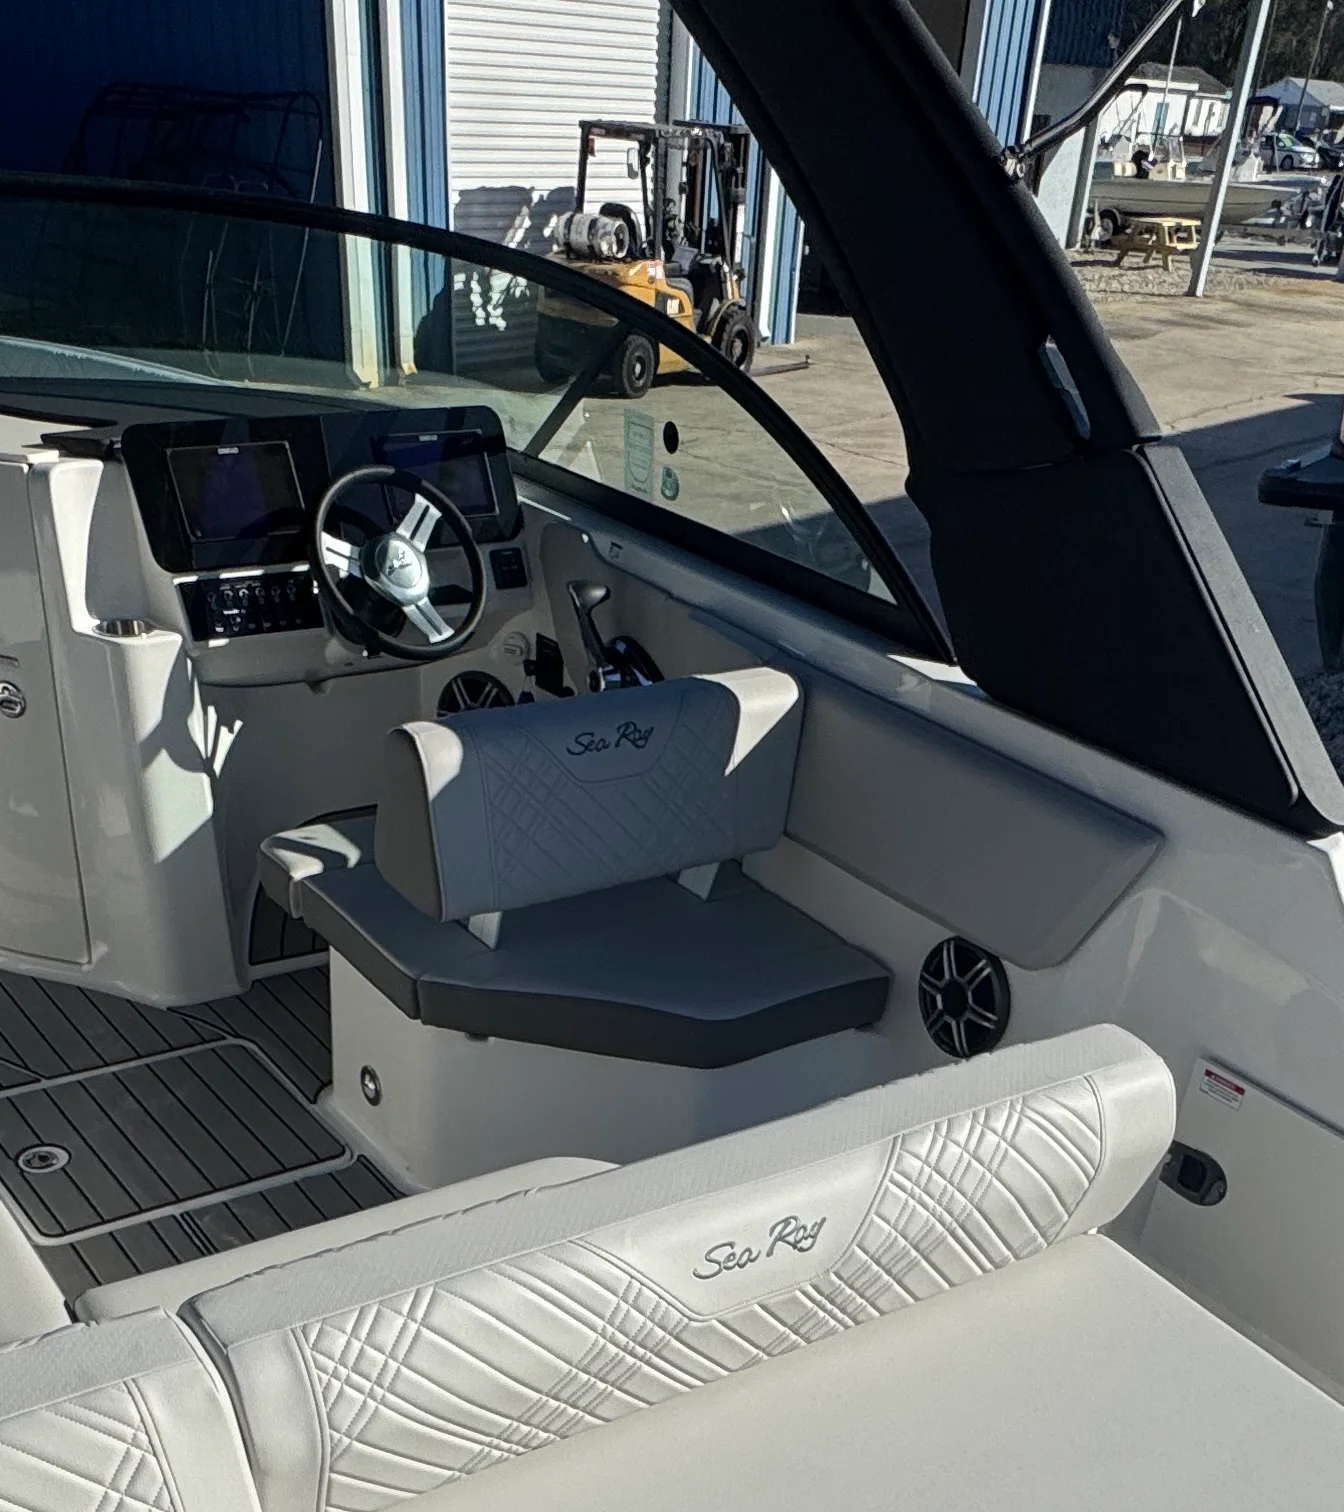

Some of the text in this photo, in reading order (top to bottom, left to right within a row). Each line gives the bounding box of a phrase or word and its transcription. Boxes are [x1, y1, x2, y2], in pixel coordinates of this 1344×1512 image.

[565, 720, 655, 756] Sea Ray
[692, 1215, 827, 1280] Sea Ray
